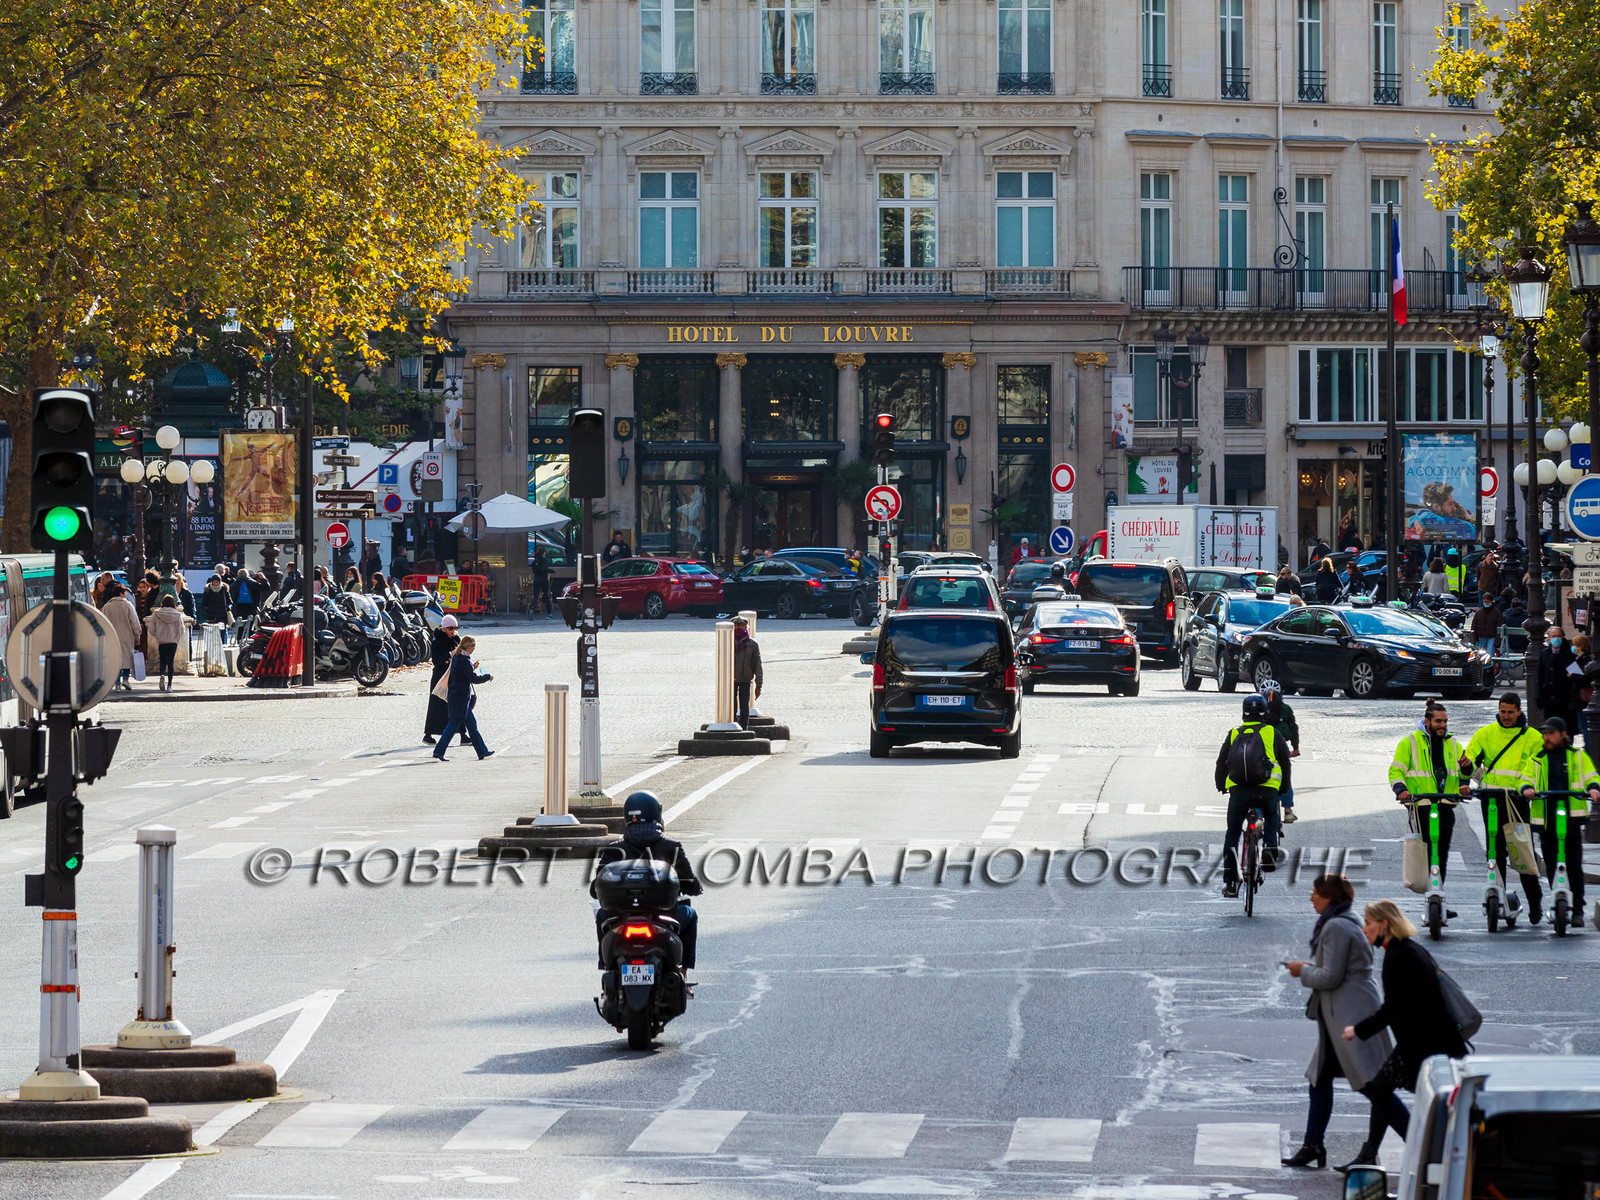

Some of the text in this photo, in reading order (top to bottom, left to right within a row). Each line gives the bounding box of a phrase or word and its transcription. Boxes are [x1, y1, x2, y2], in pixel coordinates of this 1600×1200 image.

[667, 326, 914, 342] HOTEL DU LOUVRE
[384, 468, 393, 481] P
